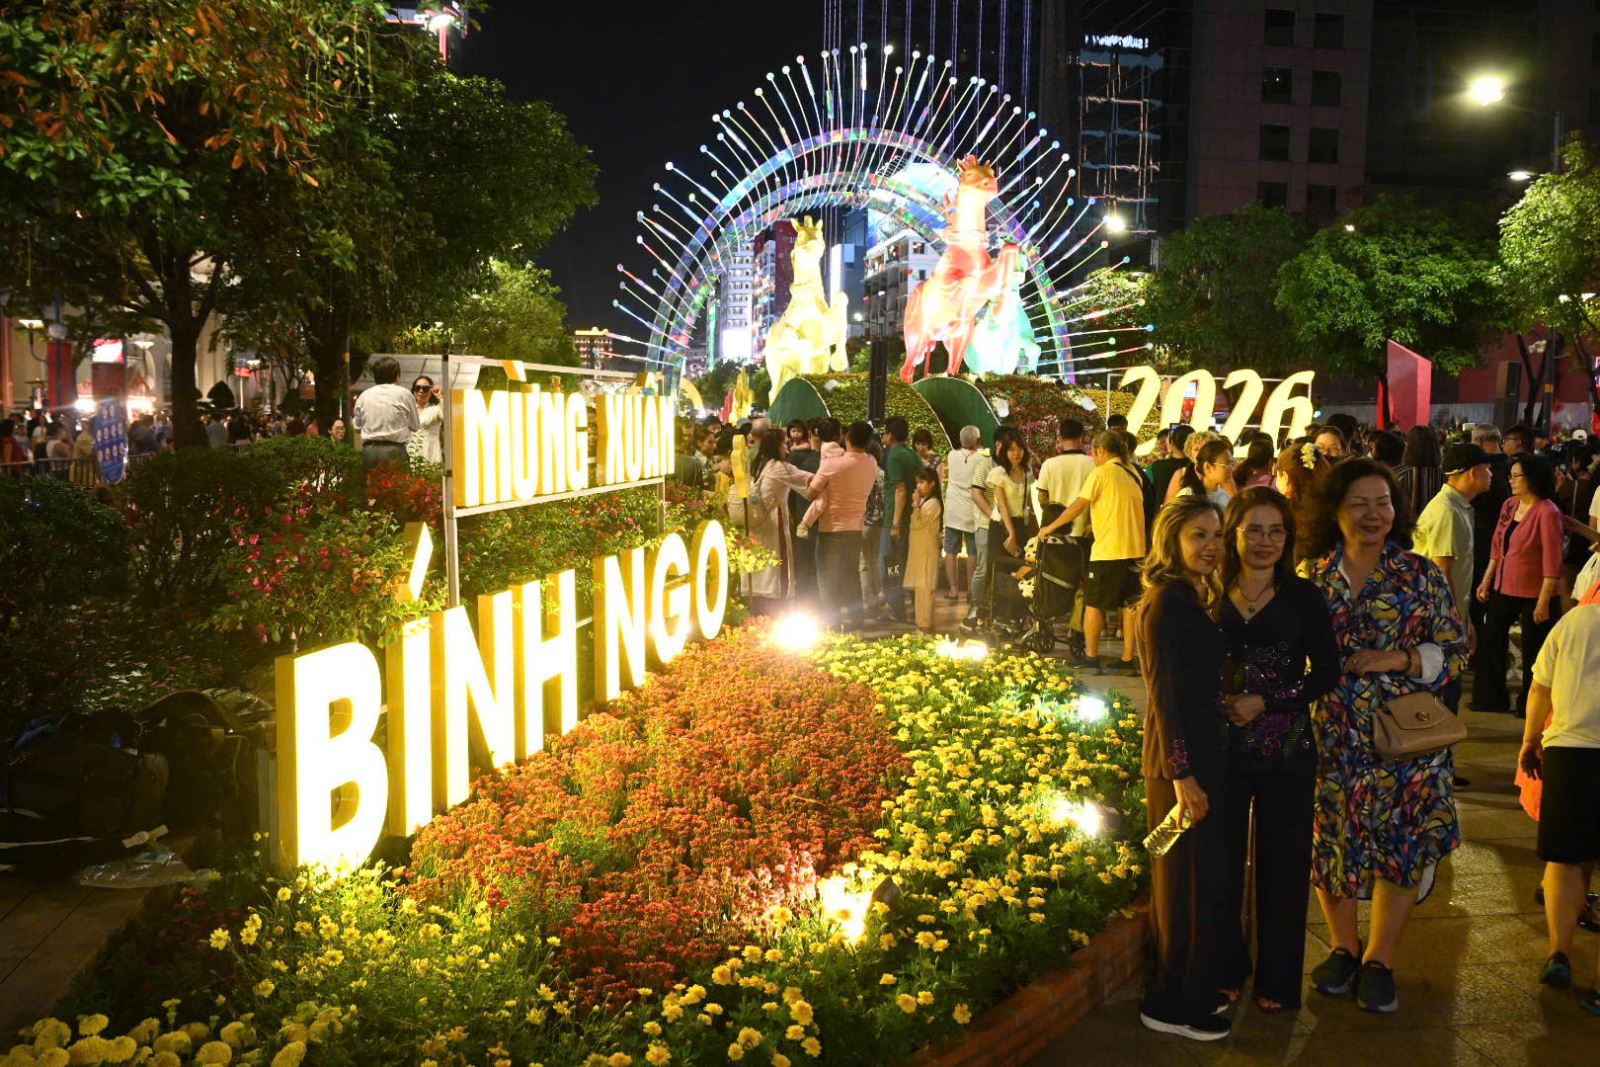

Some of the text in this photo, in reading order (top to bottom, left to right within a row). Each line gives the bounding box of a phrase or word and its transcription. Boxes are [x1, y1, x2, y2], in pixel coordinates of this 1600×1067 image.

[462, 360, 676, 507] MỪNG XUÂN
[1120, 365, 1316, 458] 2026
[294, 521, 578, 868] BÍNH
